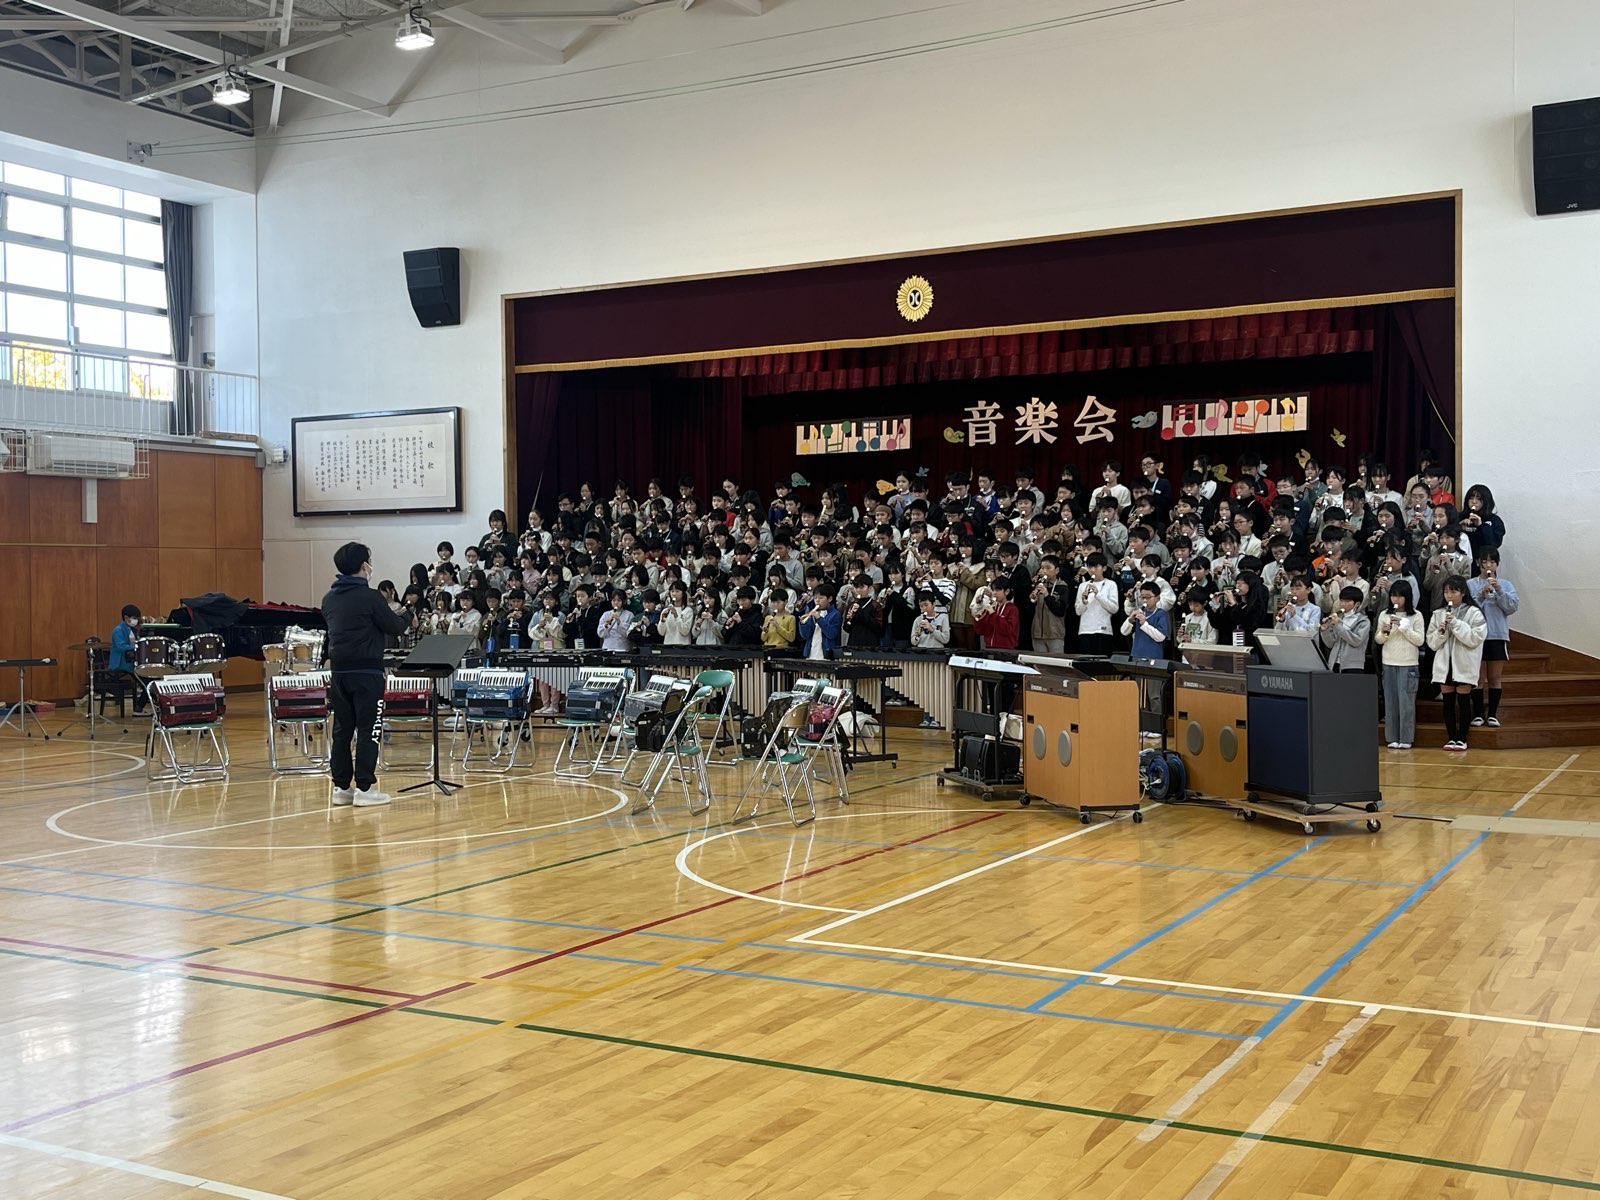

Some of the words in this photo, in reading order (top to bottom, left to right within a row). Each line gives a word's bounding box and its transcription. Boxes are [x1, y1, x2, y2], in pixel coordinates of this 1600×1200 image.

[962, 395, 1117, 447] 音楽会
[1268, 676, 1294, 690] YAMAHA
